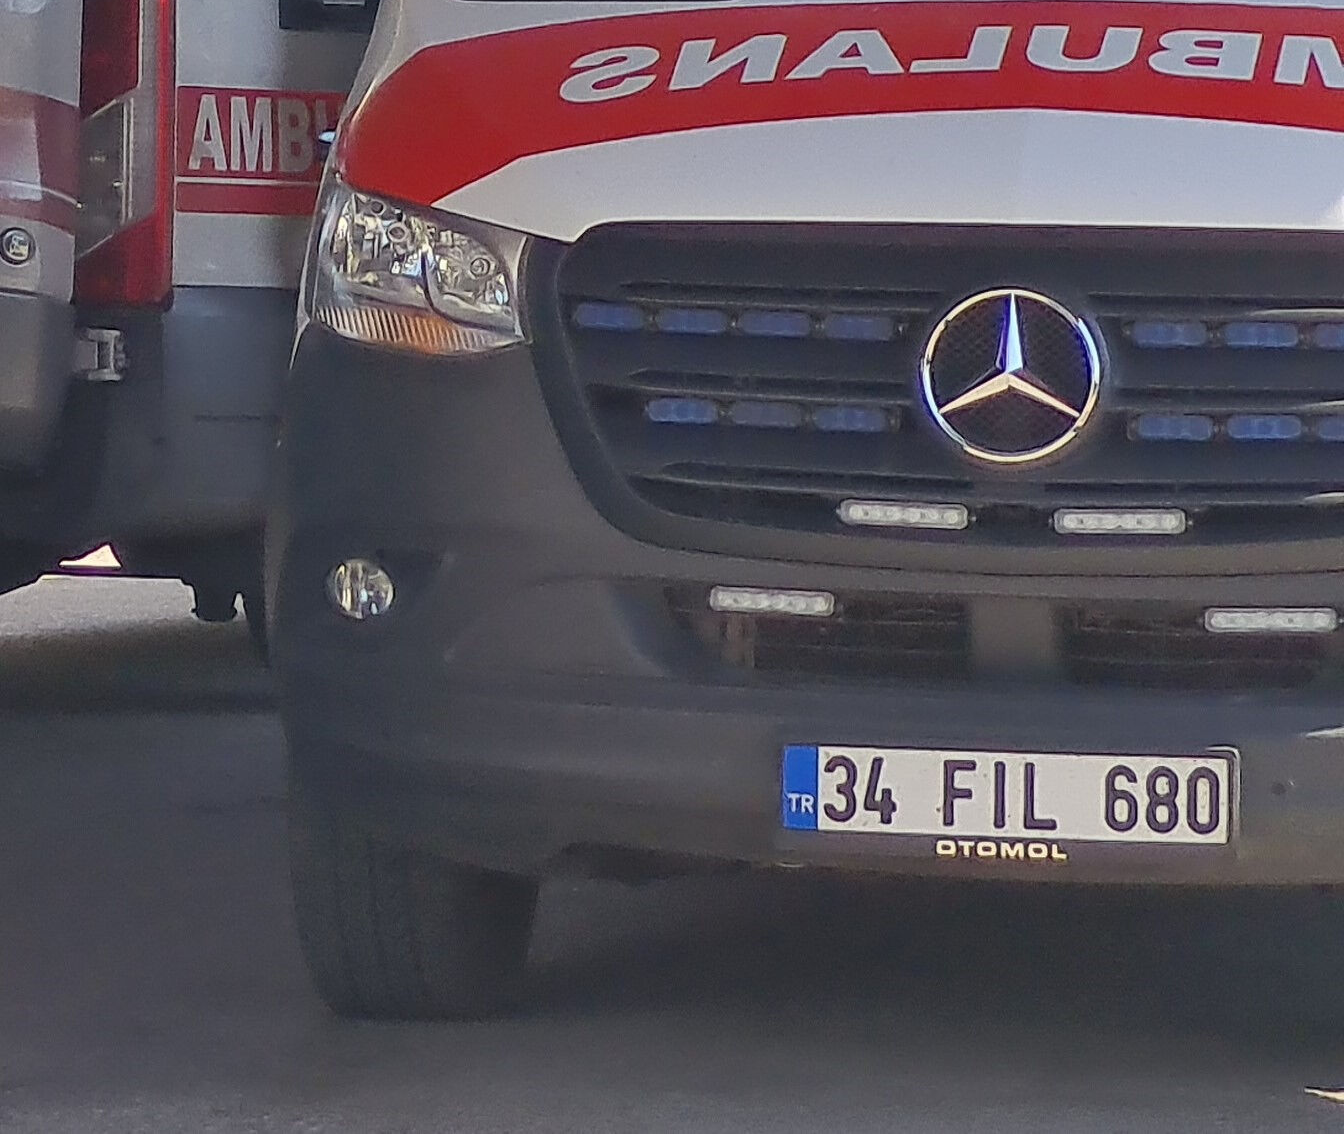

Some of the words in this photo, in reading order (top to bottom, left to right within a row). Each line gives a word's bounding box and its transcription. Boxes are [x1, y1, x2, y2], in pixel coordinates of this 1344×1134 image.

[787, 793, 814, 814] TR
[823, 755, 897, 825] 34
[942, 759, 1058, 831] FIL
[1104, 765, 1222, 834] 680
[935, 839, 1068, 861] OTOMOL
